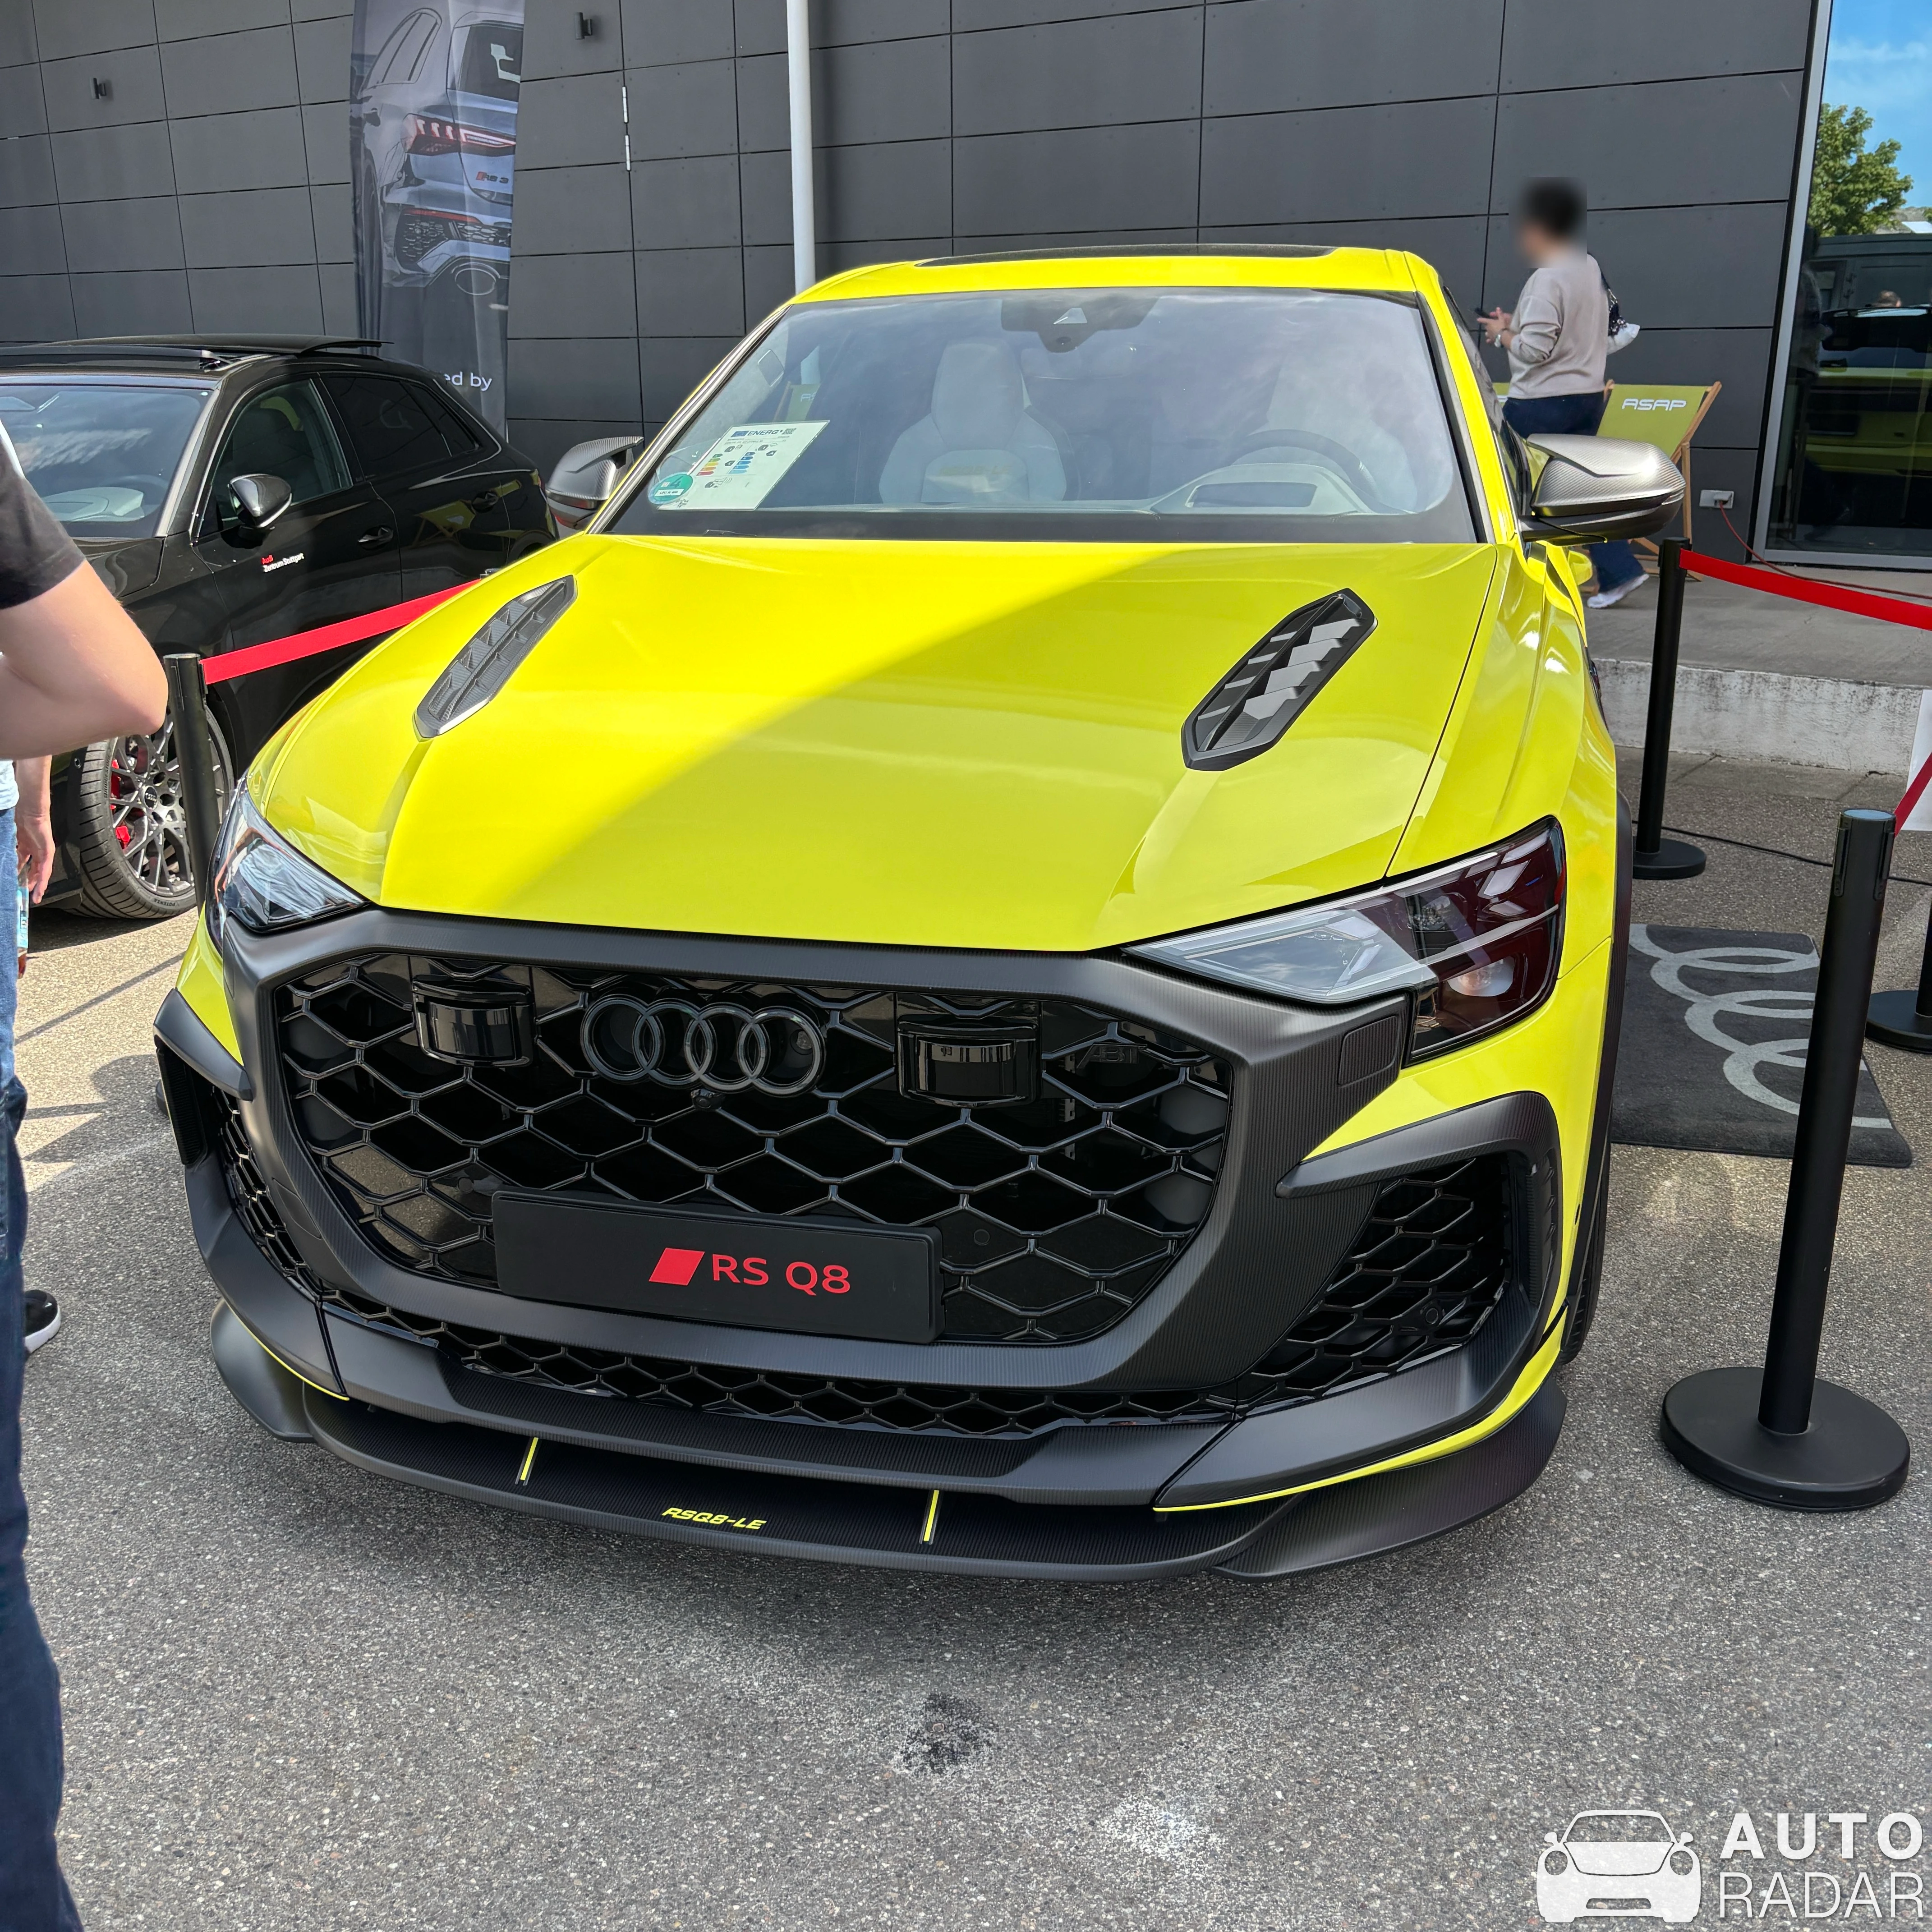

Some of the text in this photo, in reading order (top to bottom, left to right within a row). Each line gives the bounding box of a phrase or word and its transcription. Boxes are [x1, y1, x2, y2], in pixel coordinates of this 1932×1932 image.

[470, 372, 492, 391] by
[1621, 398, 1687, 411] ASAP
[669, 476, 684, 488] 4
[262, 555, 274, 564] Audi
[1076, 1042, 1148, 1068] ABT
[713, 1254, 851, 1296] RS Q8
[662, 1507, 767, 1530] RSQ8-LE
